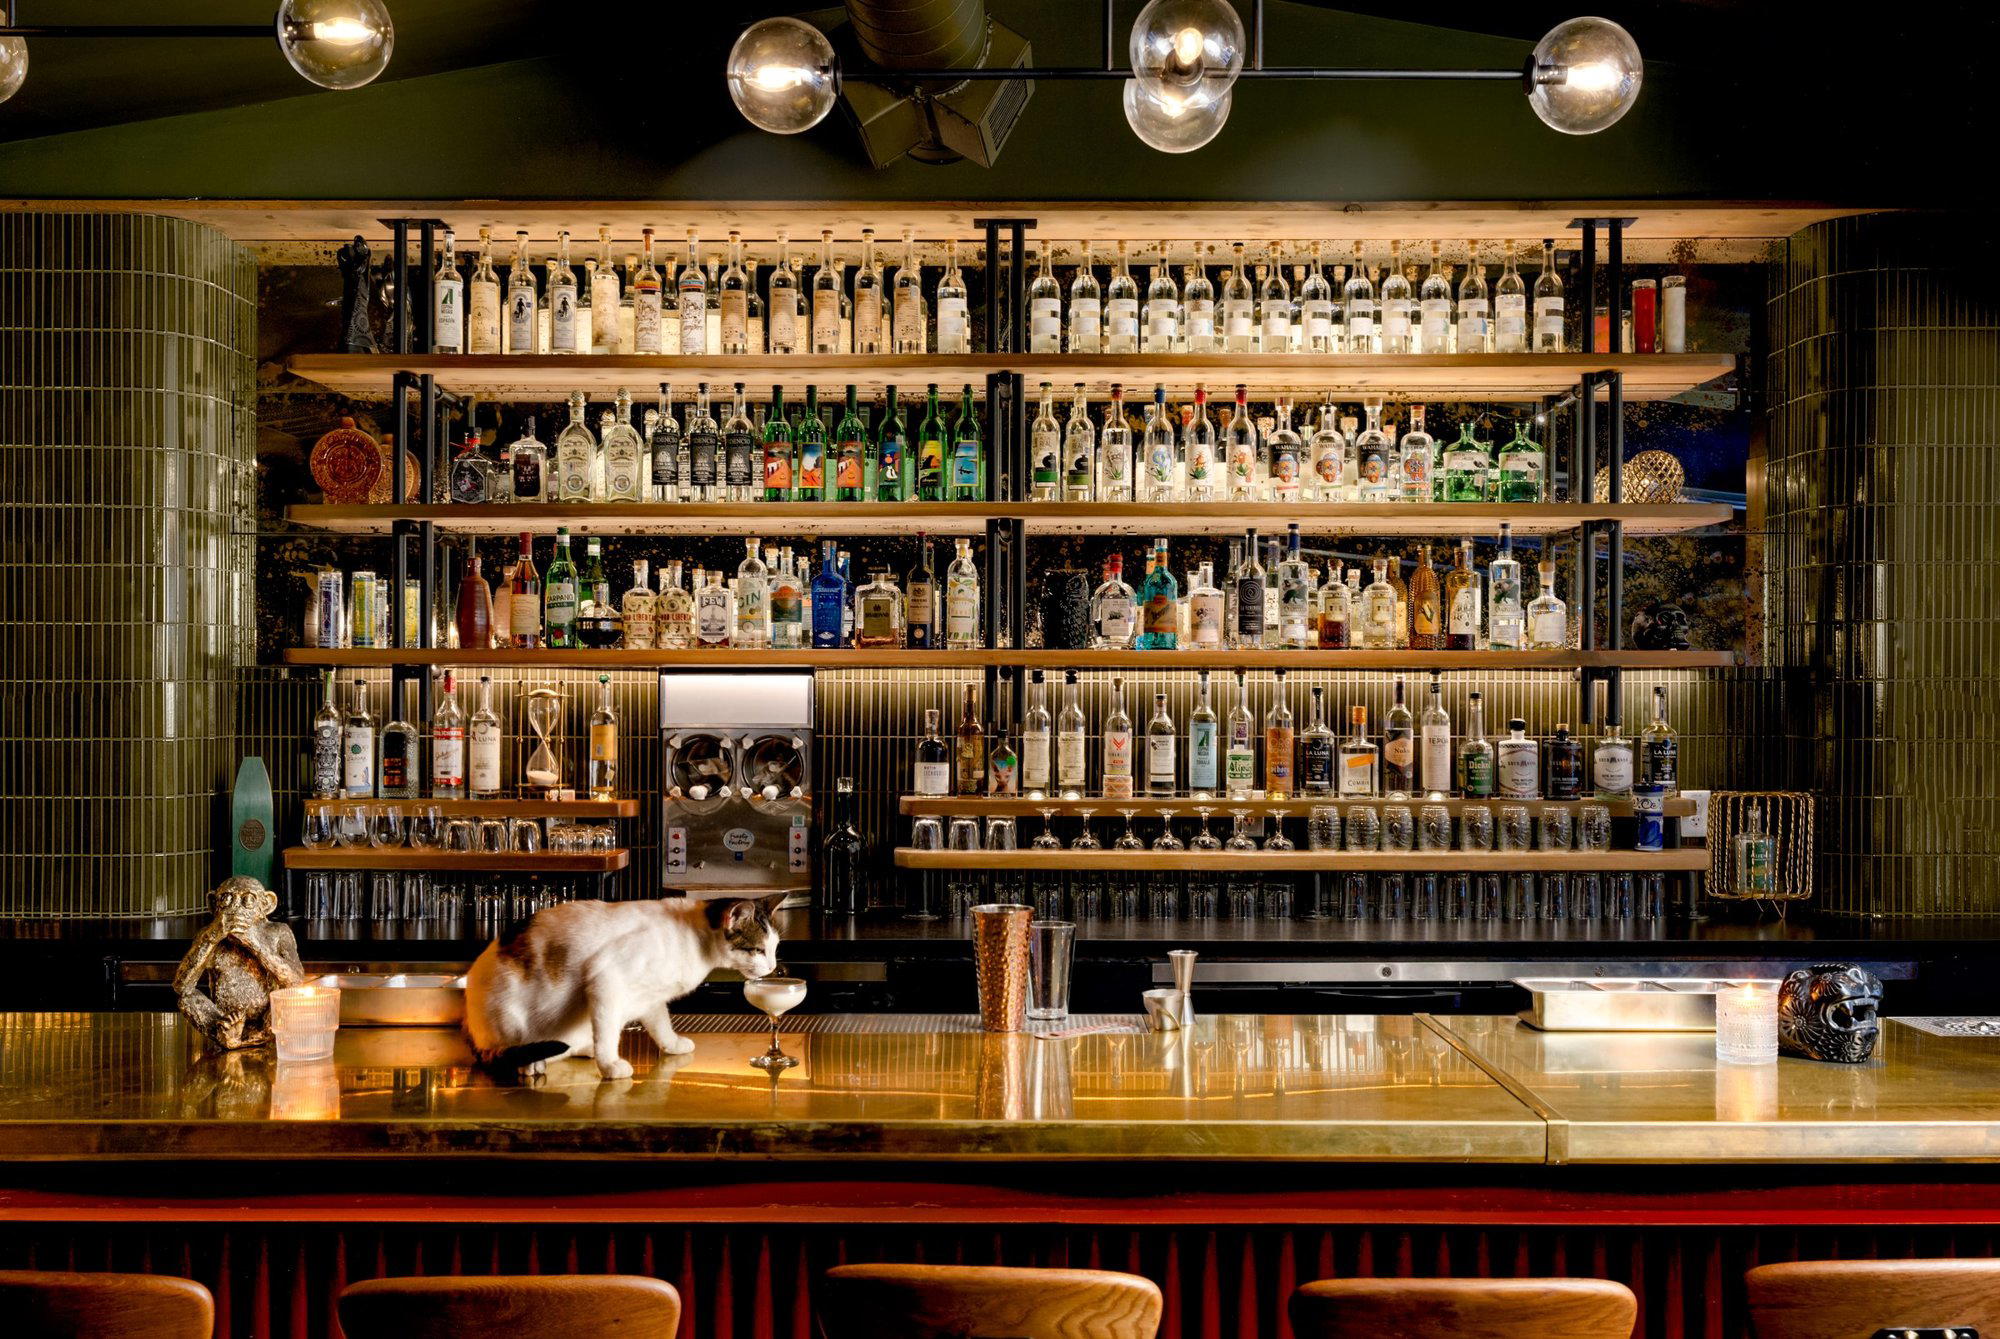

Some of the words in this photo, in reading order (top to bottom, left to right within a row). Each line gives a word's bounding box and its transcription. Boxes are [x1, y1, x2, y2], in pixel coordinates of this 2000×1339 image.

[704, 597, 724, 607] FEW
[738, 591, 760, 608] GIN
[1468, 761, 1491, 769] Dickel
